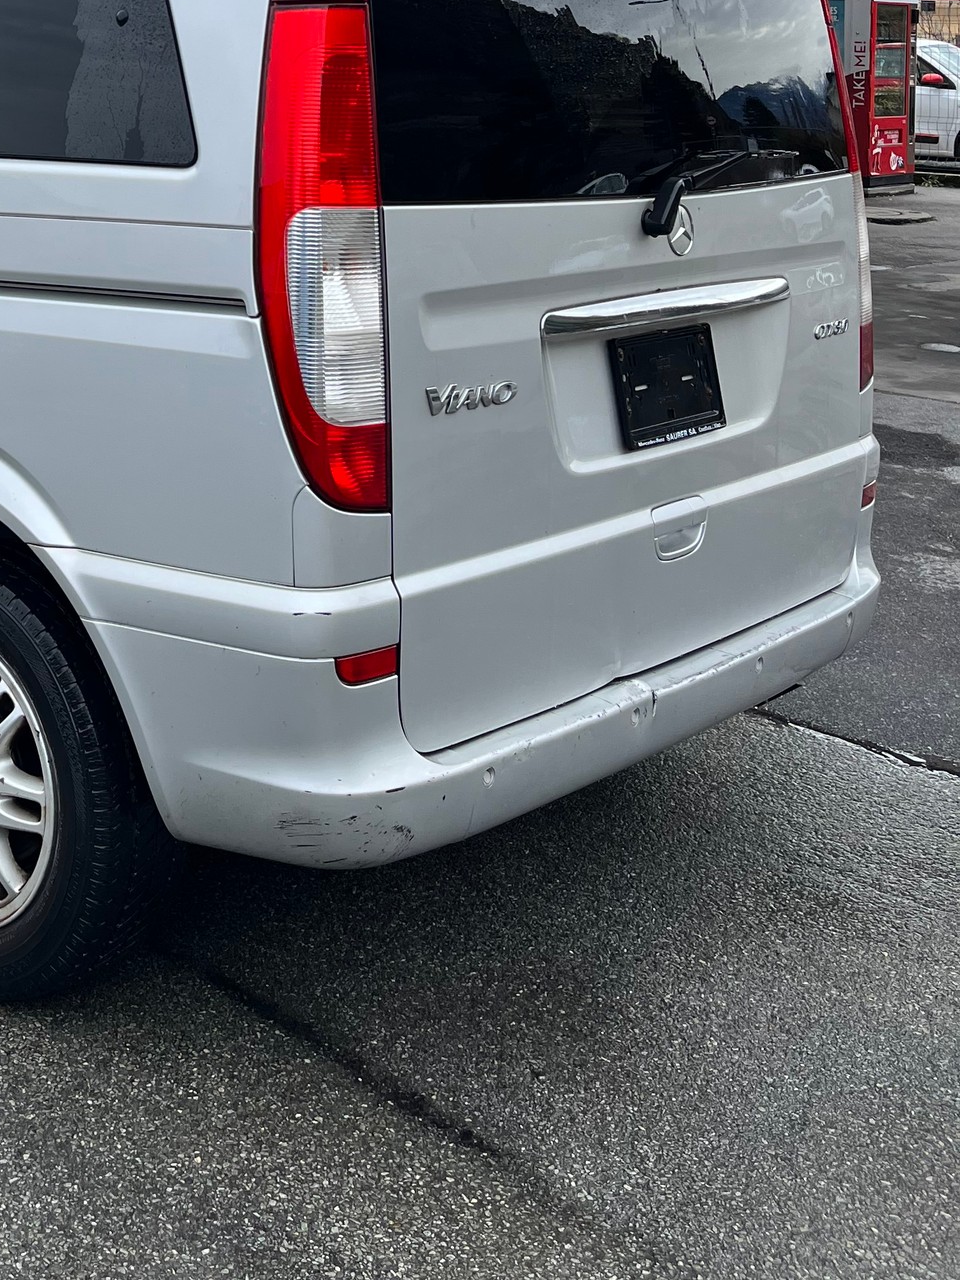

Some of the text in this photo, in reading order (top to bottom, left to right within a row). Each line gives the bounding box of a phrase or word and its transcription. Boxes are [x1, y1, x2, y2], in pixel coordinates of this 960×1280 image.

[852, 41, 867, 108] TAKE ME!
[425, 380, 518, 417] VIANO
